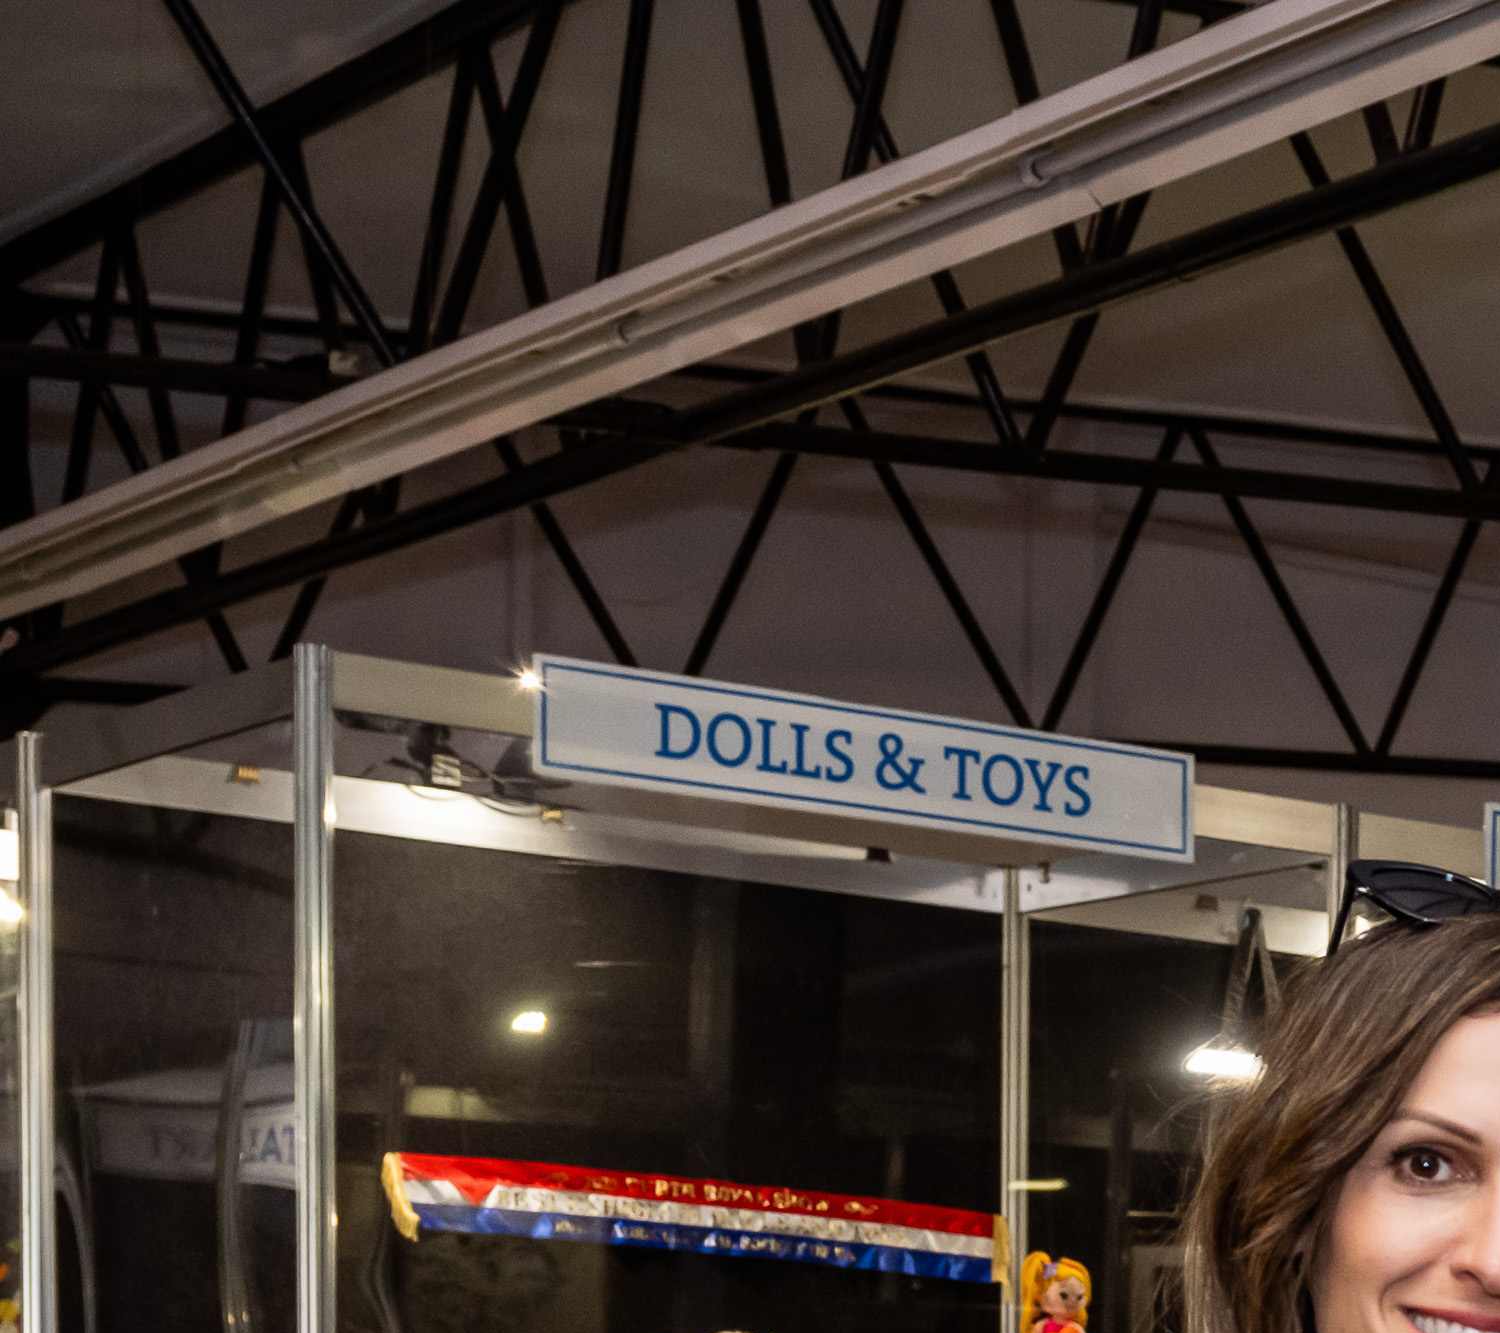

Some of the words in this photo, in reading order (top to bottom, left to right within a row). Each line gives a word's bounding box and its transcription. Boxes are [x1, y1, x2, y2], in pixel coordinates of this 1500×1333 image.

[654, 703, 855, 784] DOLLS
[875, 732, 926, 794] &
[944, 744, 1093, 818] TOYS
